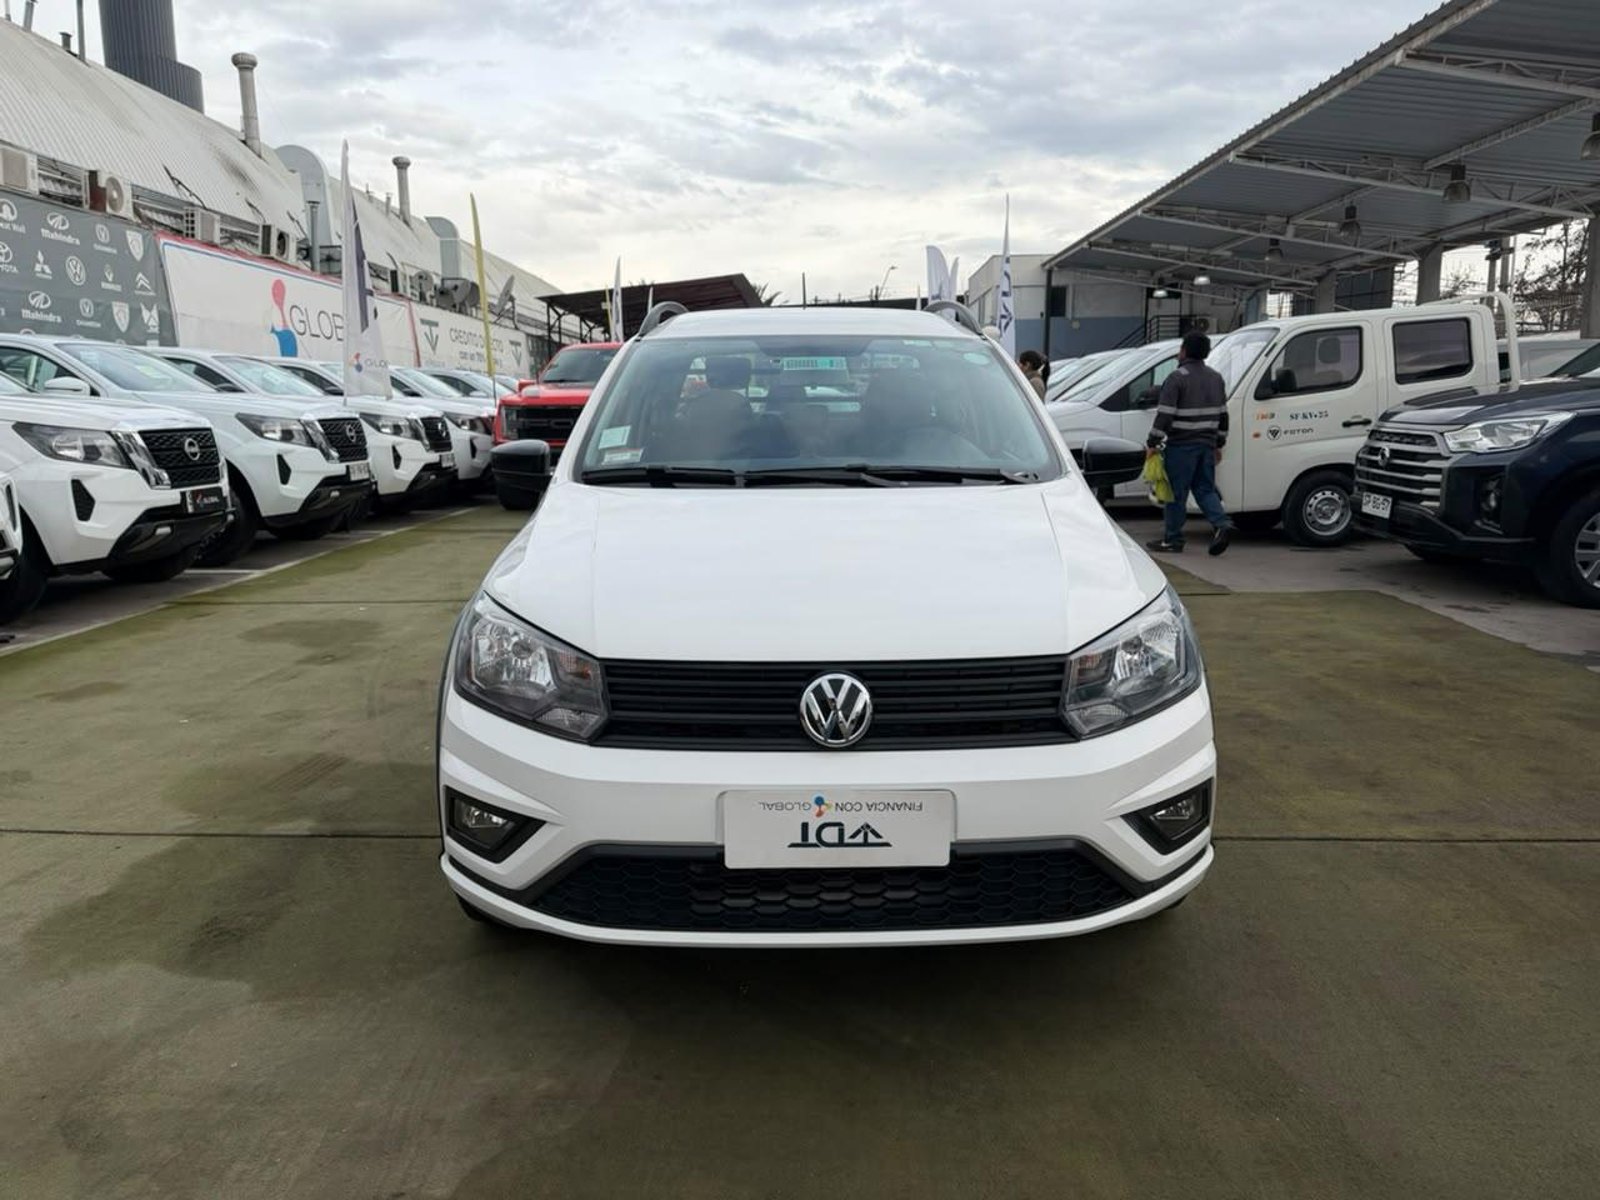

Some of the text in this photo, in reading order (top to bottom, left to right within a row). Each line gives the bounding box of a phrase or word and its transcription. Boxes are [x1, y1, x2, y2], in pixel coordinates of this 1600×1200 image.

[41, 228, 81, 246] Mahindra
[22, 309, 62, 323] Mahindra
[289, 304, 344, 342] GLOB
[1283, 427, 1315, 436] FOTON
[759, 801, 923, 812] FINANCIA CON GLOBAL
